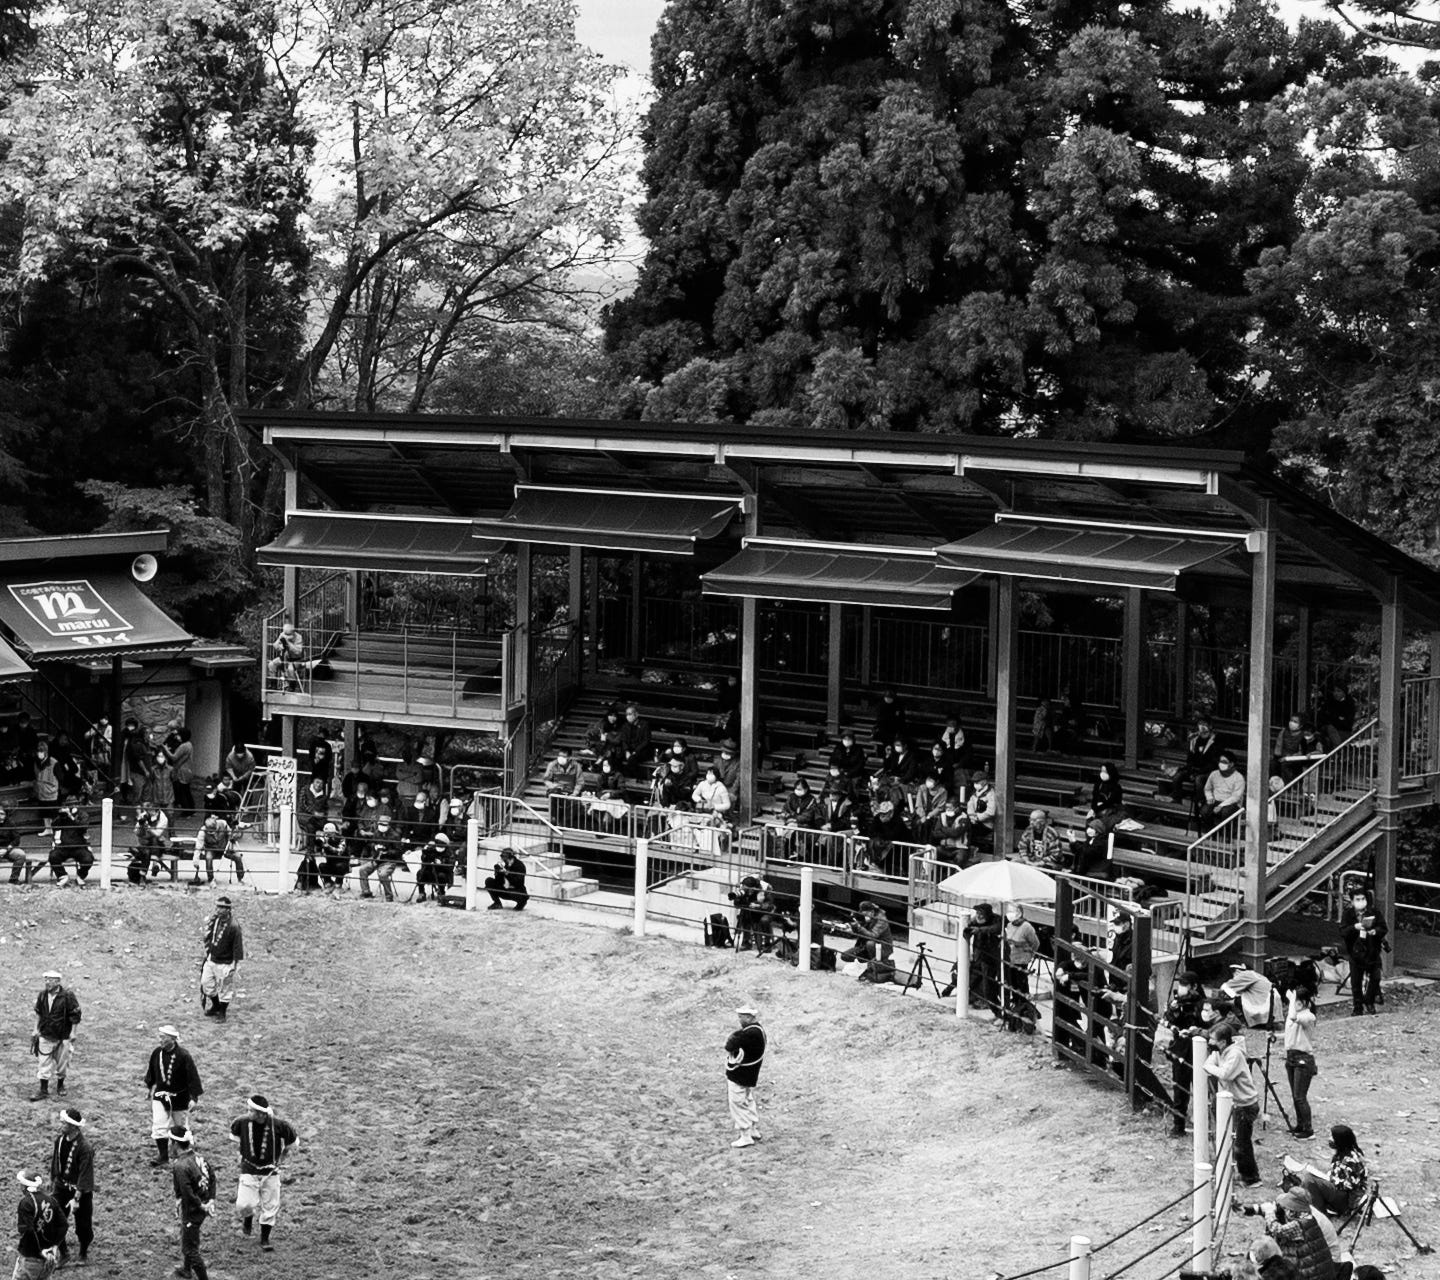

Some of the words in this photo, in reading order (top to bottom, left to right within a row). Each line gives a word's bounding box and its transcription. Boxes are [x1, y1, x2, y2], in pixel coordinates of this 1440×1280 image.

[57, 618, 111, 631] marui
[72, 632, 131, 646] マルイ
